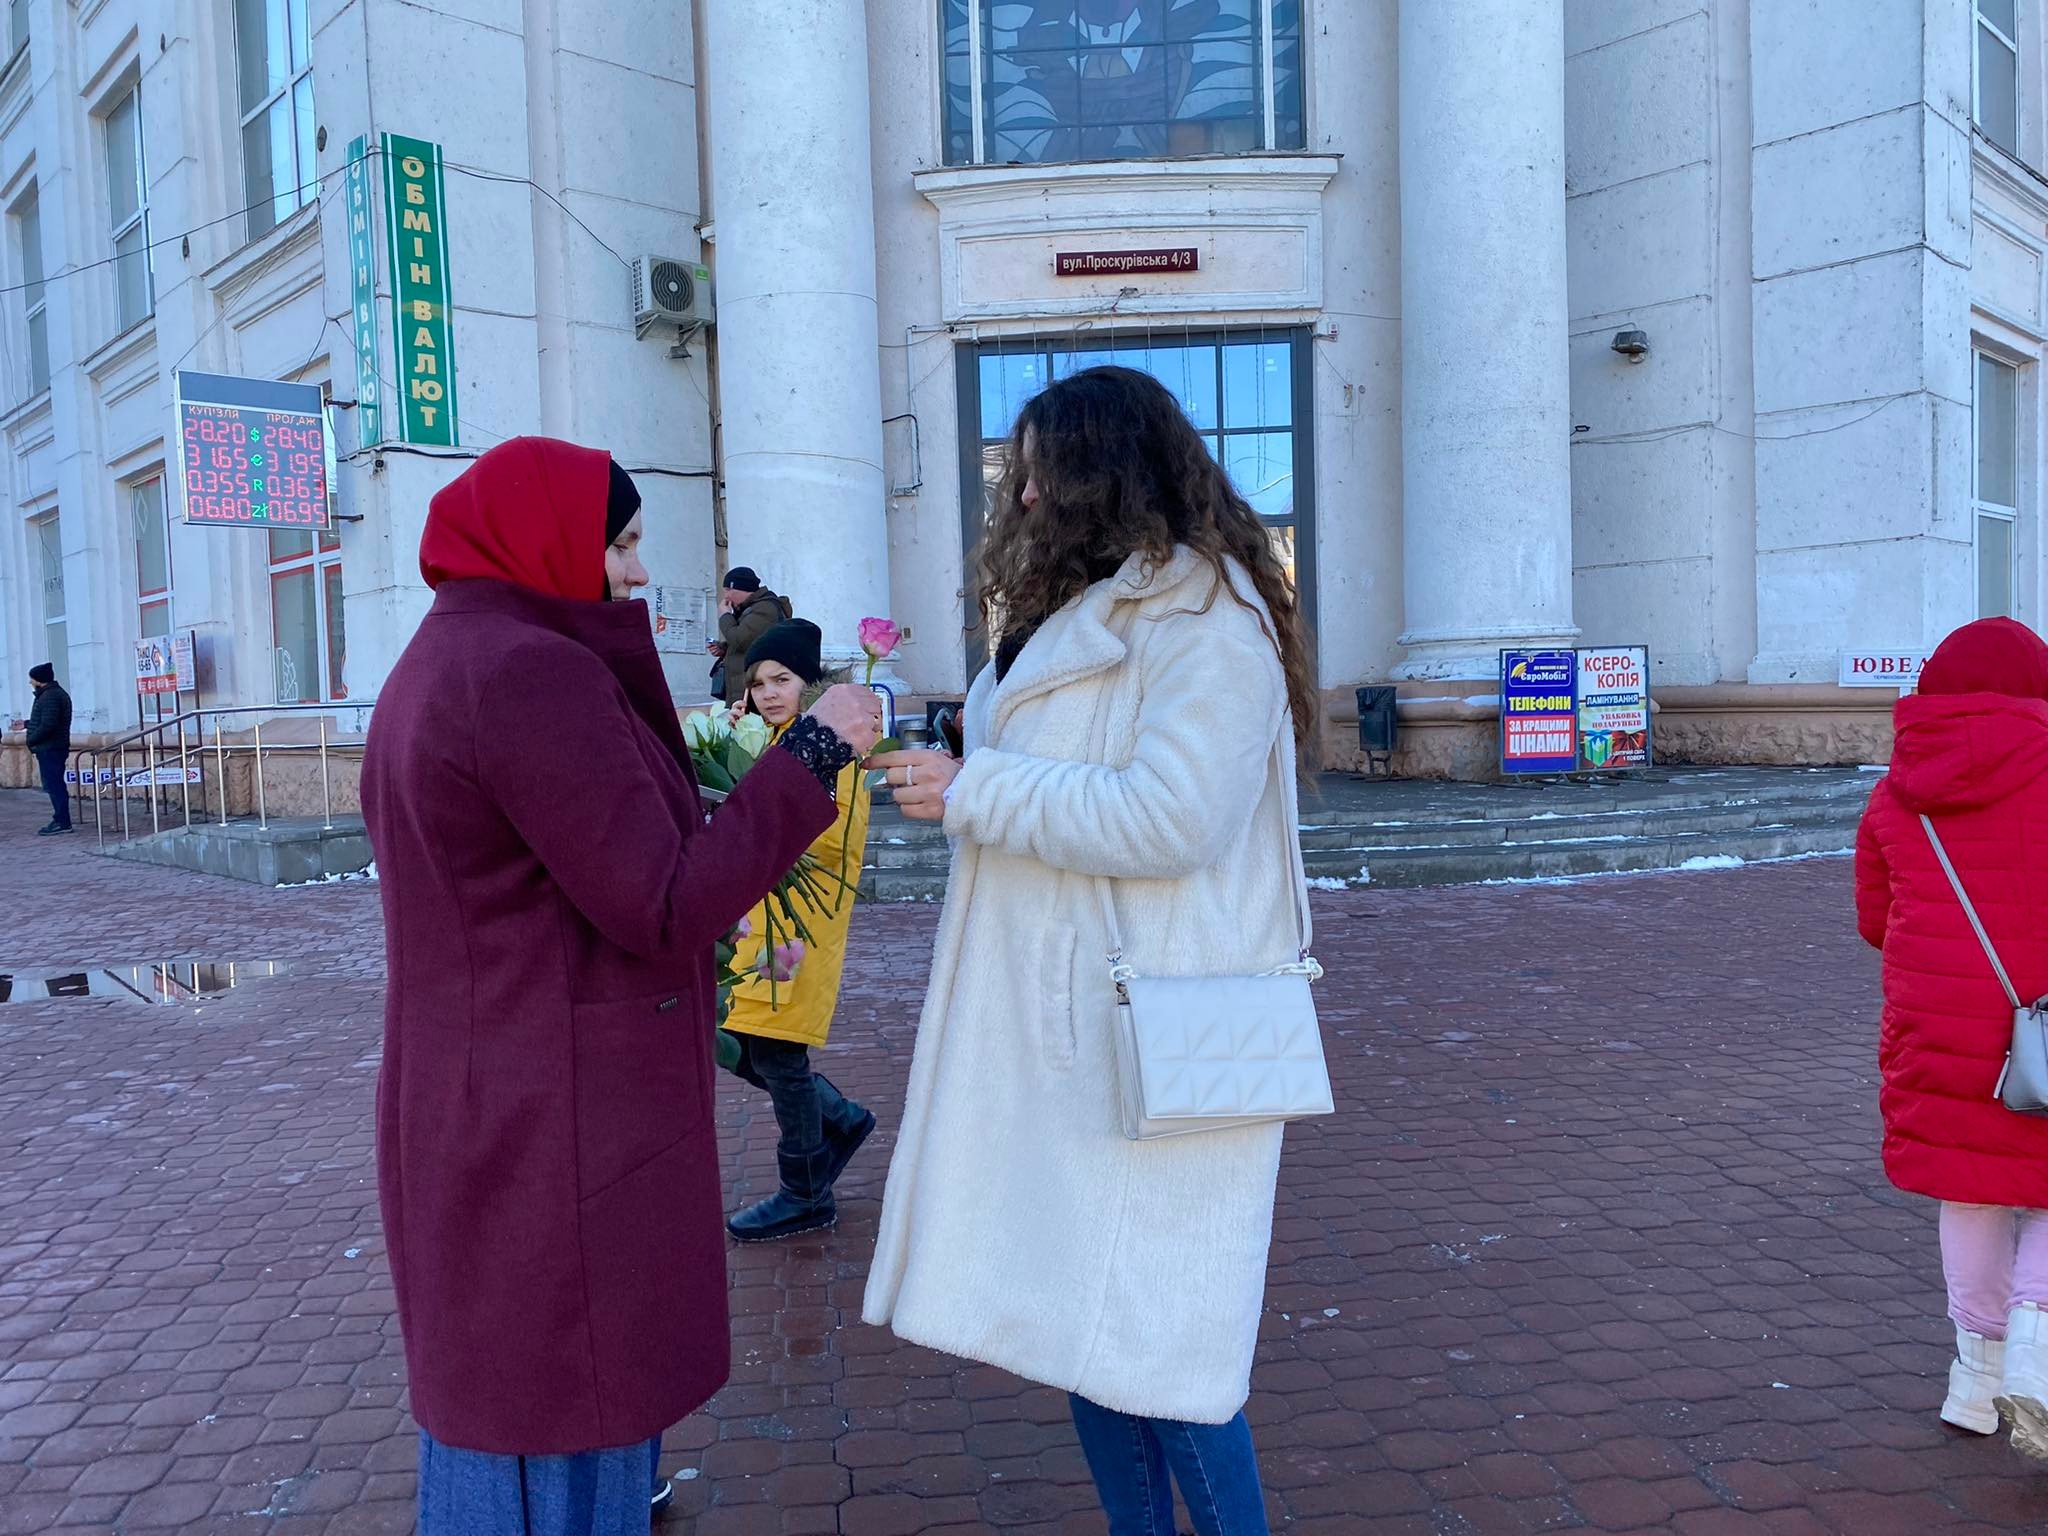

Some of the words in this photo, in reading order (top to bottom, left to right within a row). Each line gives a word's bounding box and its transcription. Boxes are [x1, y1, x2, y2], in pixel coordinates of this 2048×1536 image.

[402, 156, 432, 285] ОБМІН
[1171, 251, 1191, 268] 4/3
[352, 157, 367, 288] ОБМІН
[360, 303, 376, 429] ВАЛЮТ
[411, 299, 443, 427] ВАЛЮТ
[184, 418, 246, 445] 28.20
[251, 427, 260, 443] $
[263, 426, 322, 451] 28.40
[253, 479, 263, 491] R
[1584, 655, 1636, 672] КСЕРО-
[1521, 671, 1568, 683] ЄвроМобіл
[1597, 672, 1639, 688] КОПІЯ
[1508, 695, 1572, 711] ТЕЛЕФОНИ
[1587, 694, 1639, 705] ЛАМІНУВАННЯ
[1600, 711, 1641, 720] УПАКОВКА
[1509, 721, 1521, 732] ЗА
[1523, 719, 1570, 733] КРАЩИМИ
[1509, 733, 1570, 756] ЦІНАМИ
